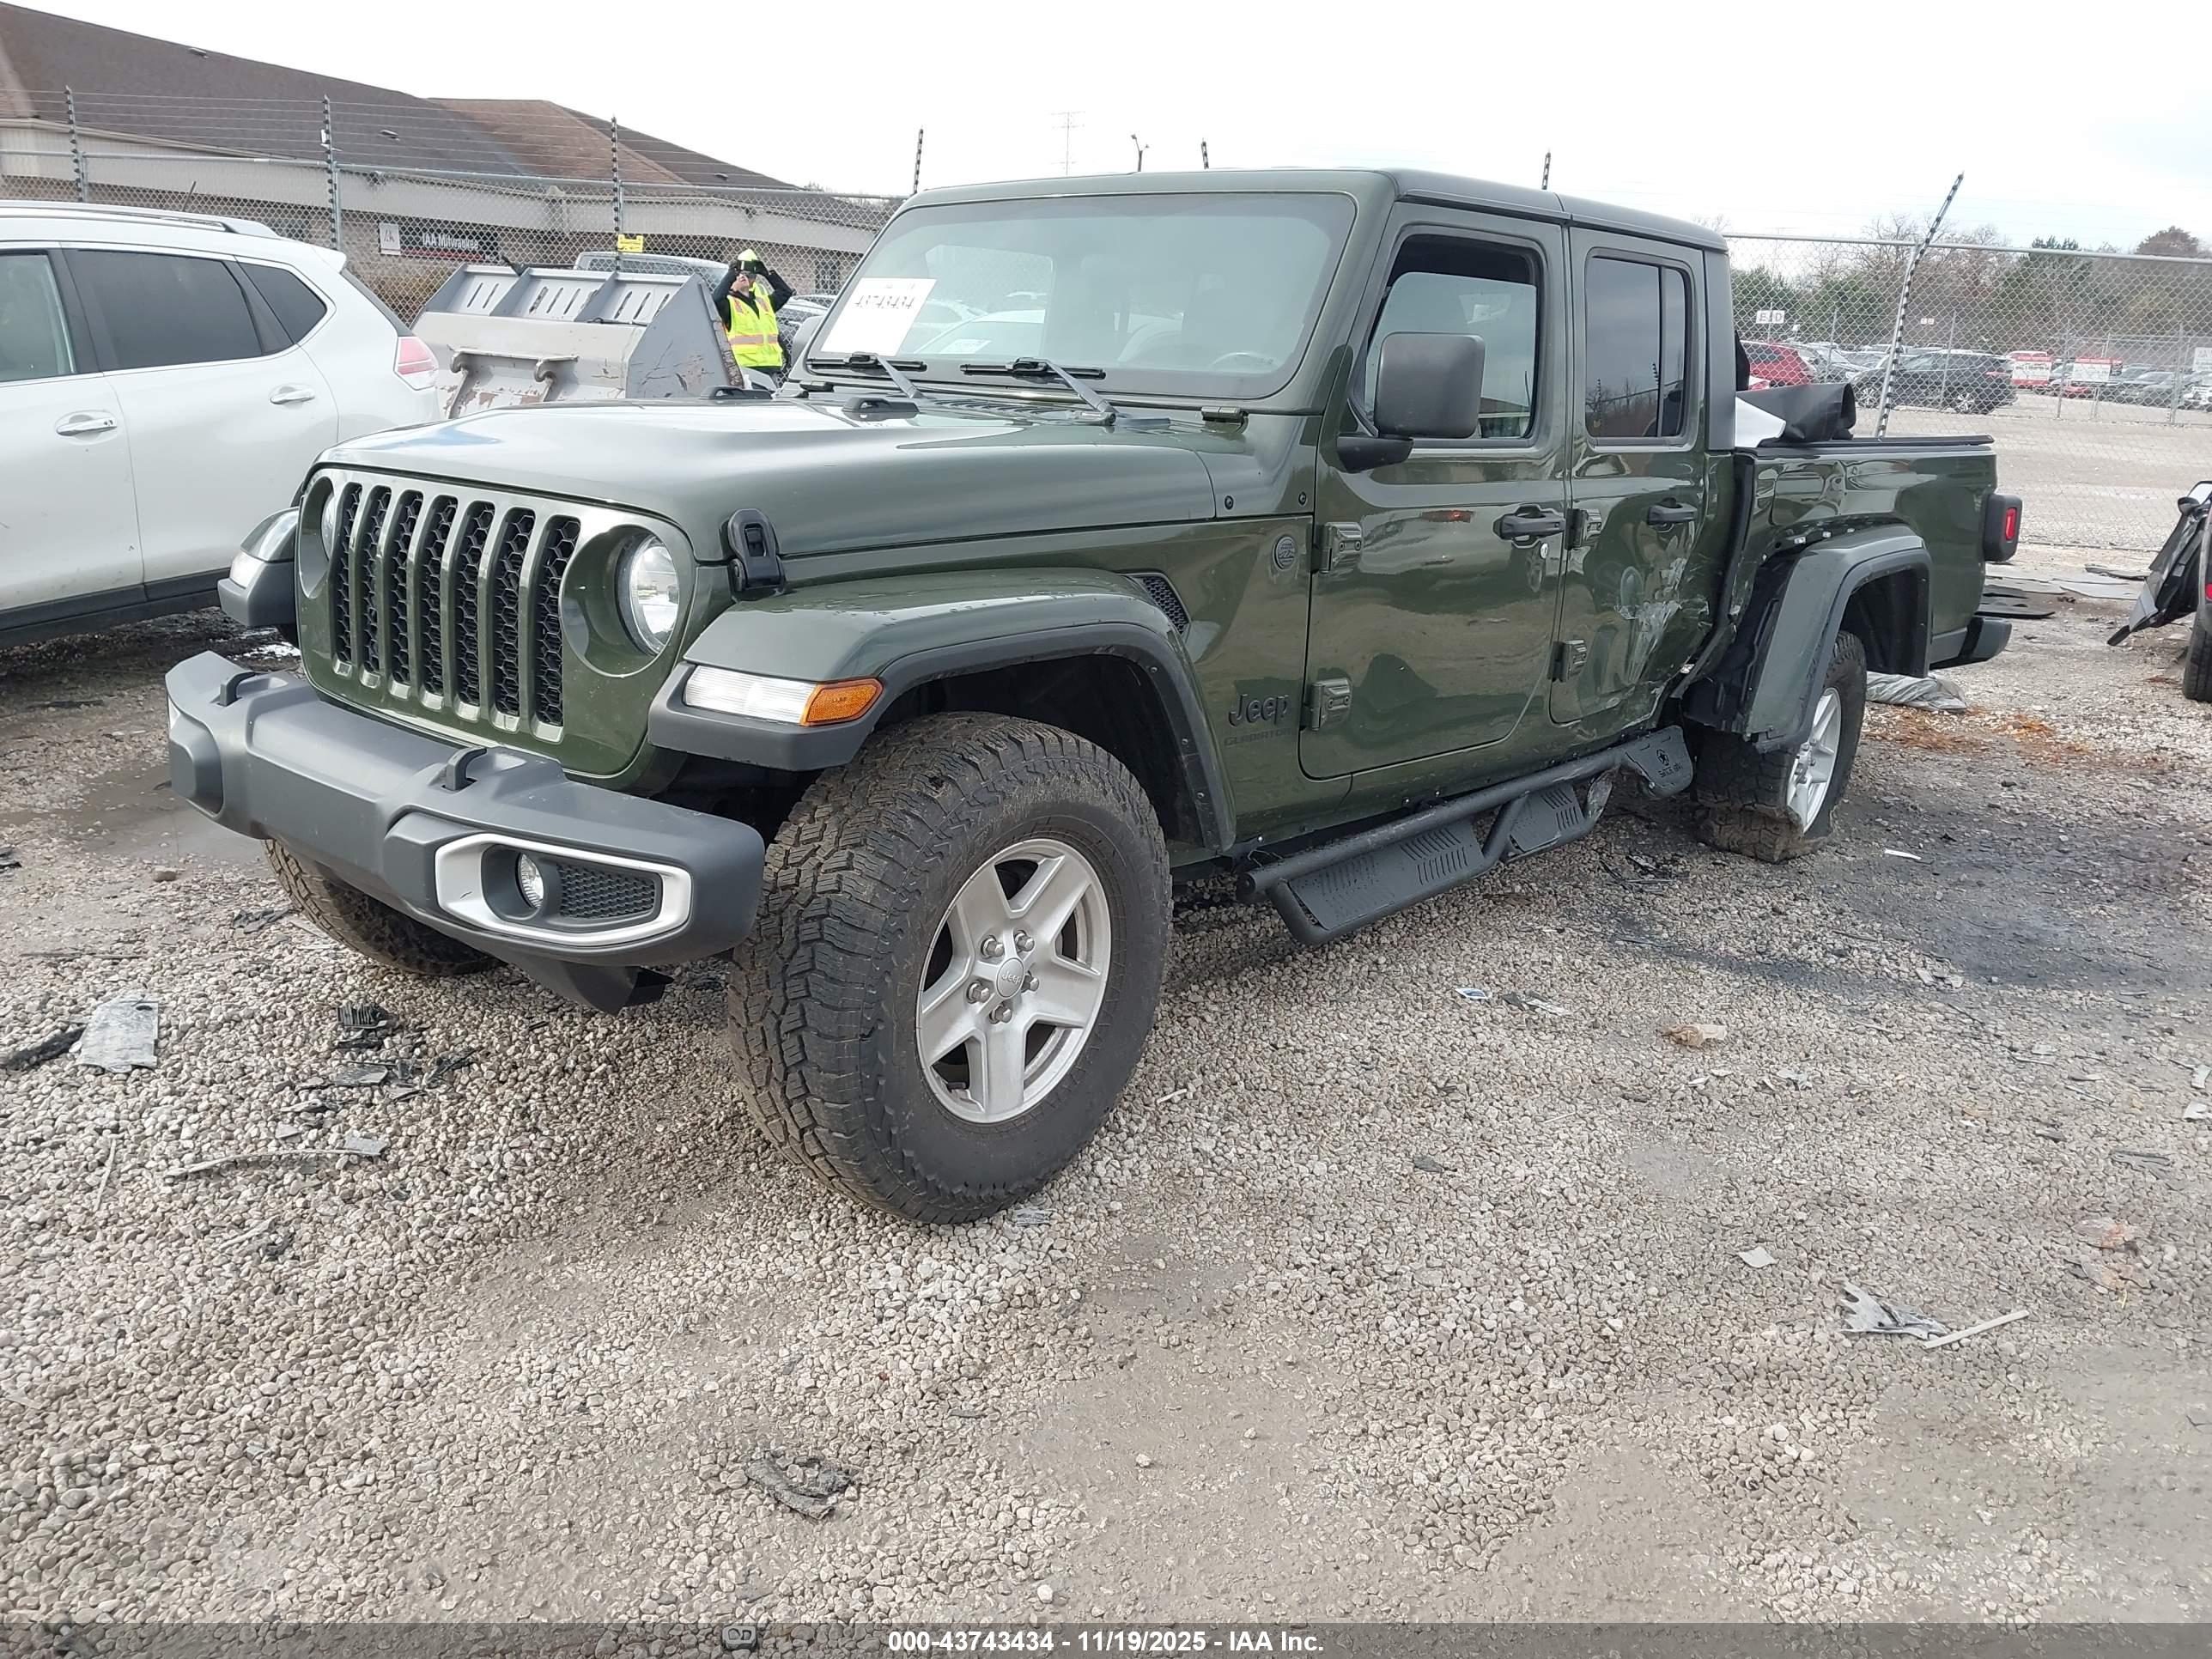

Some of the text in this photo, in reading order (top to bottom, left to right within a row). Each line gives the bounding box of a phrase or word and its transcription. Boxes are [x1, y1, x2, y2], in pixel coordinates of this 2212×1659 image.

[422, 233, 437, 246] IAA
[1228, 693, 1290, 728] Jeep
[1224, 727, 1292, 747] GLADIATOR
[1001, 970, 1023, 986] Jeep
